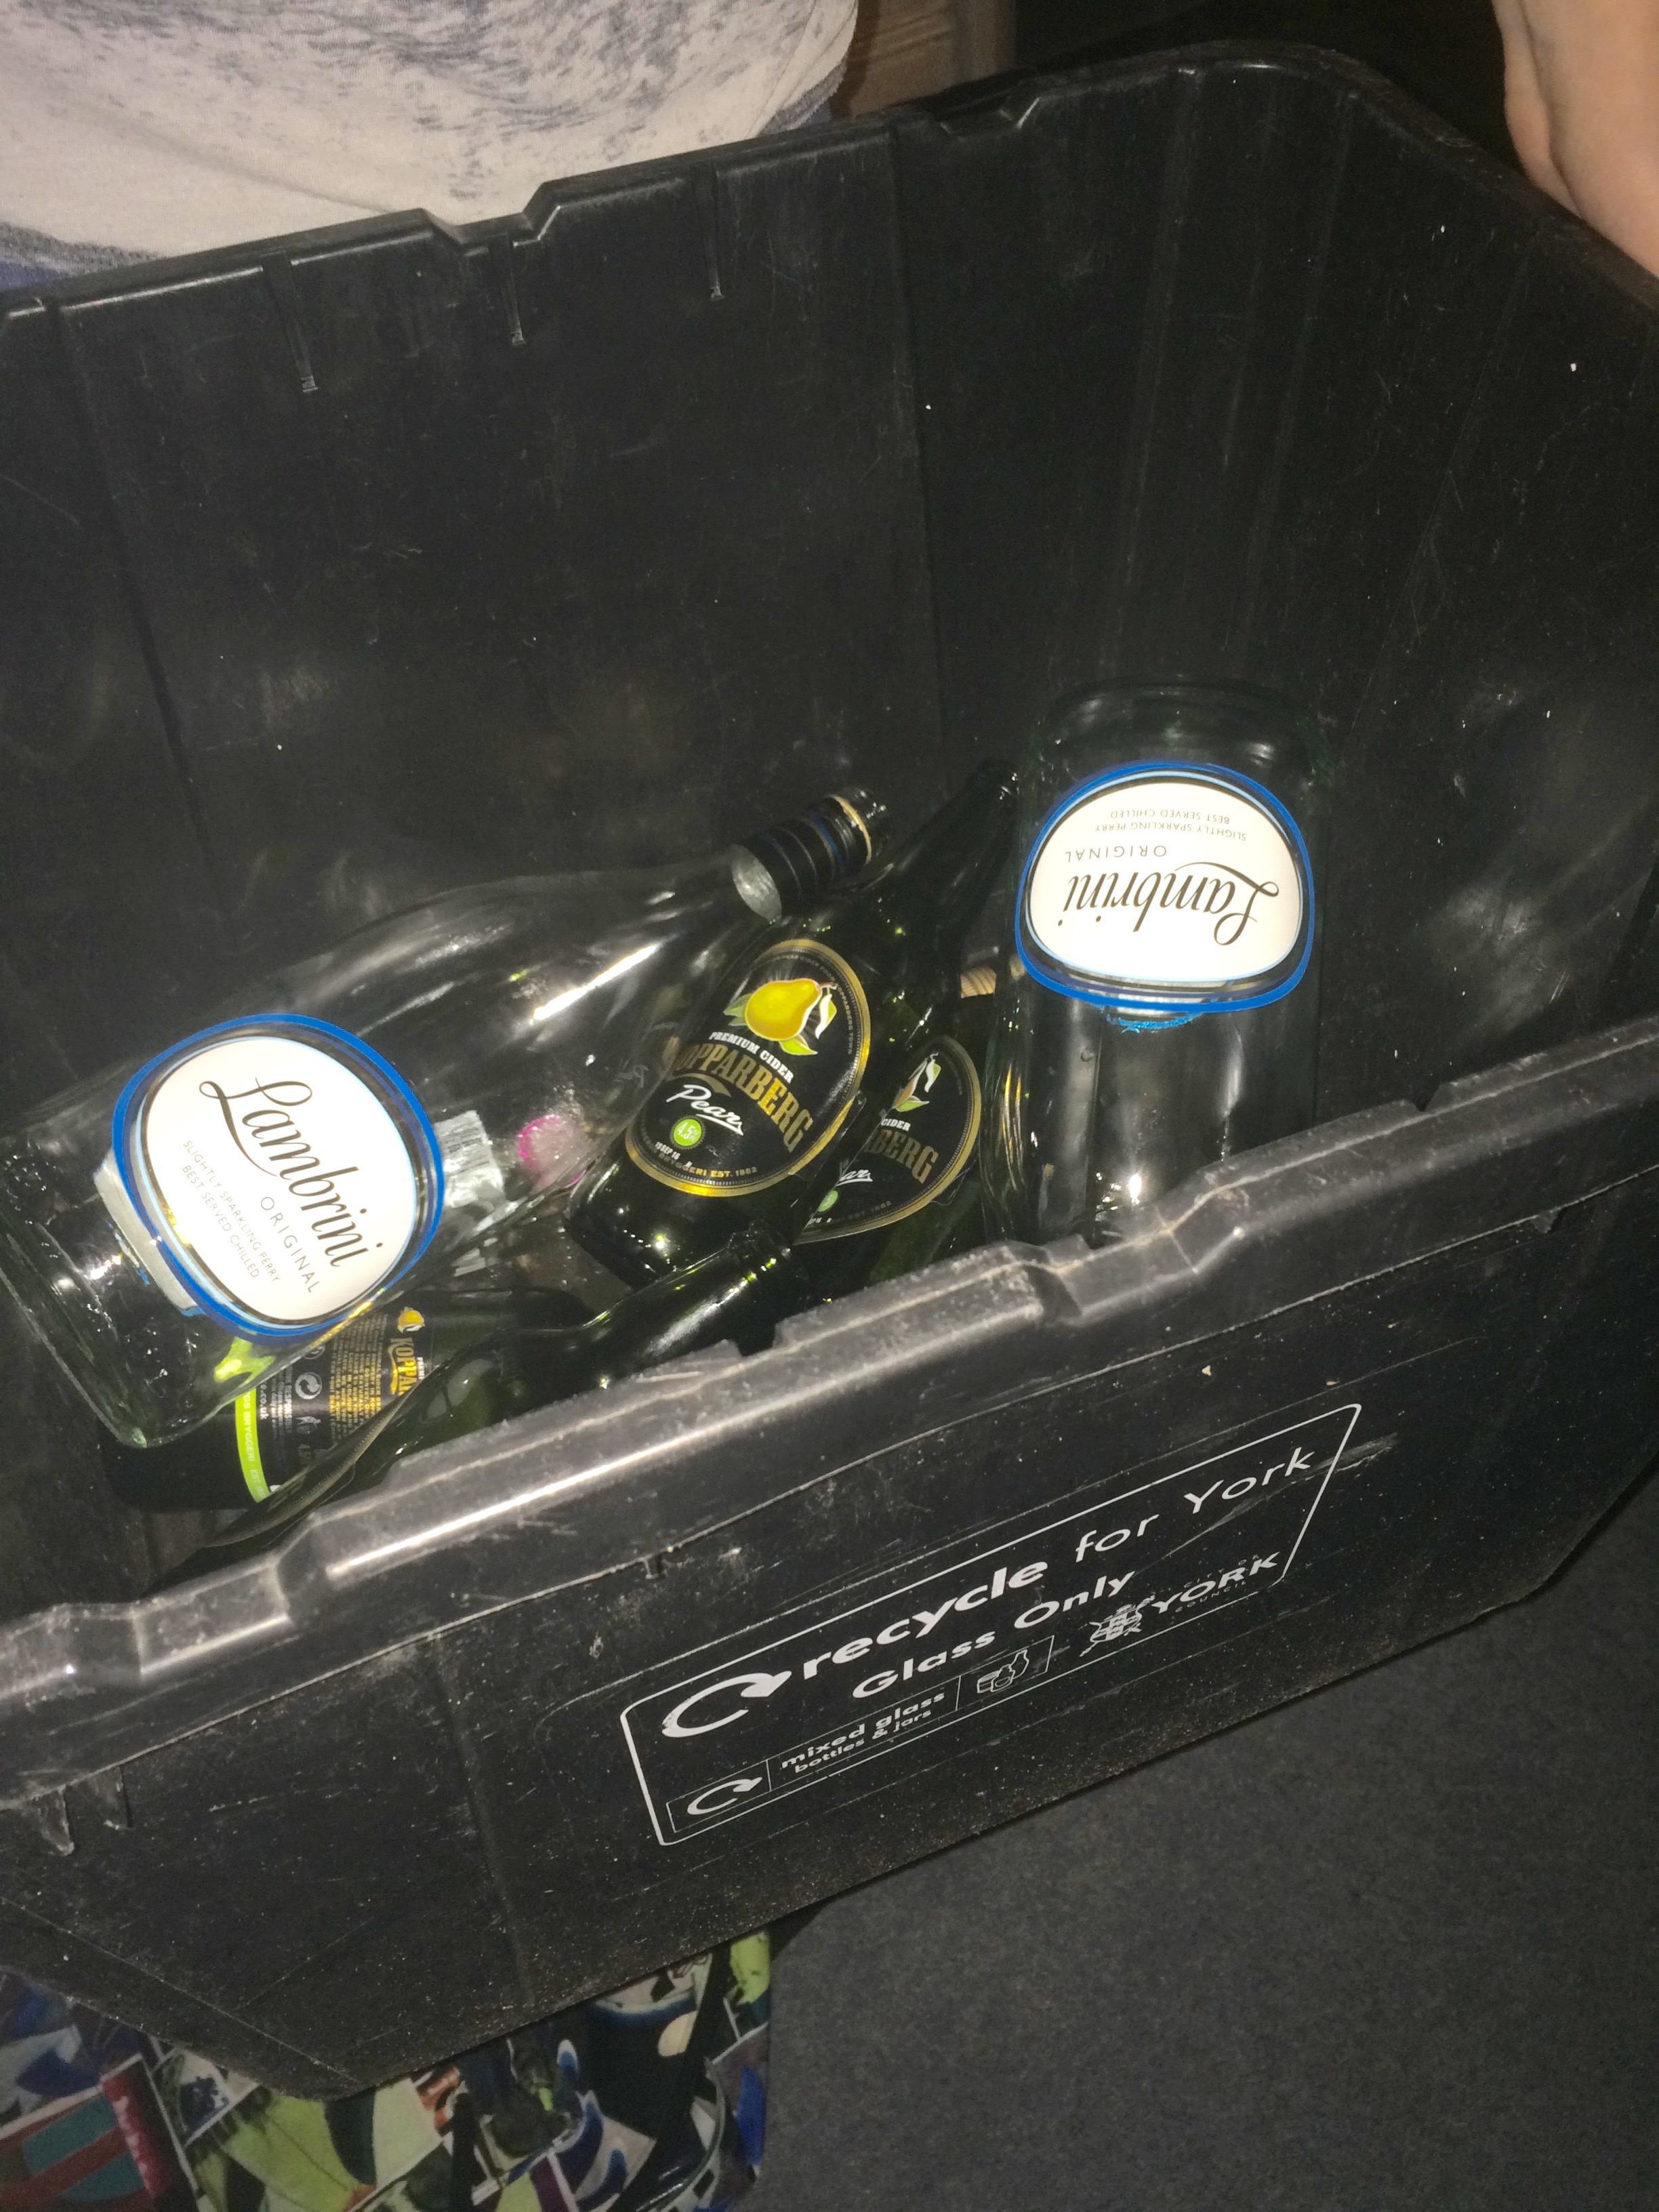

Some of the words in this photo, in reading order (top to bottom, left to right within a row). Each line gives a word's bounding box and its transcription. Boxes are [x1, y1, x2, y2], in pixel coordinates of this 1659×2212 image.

[1094, 823, 1126, 833] PERRY
[1110, 809, 1155, 819] CHILLED
[1130, 822, 1192, 832] SPARKLING
[1160, 810, 1201, 821] SERVED
[1197, 825, 1246, 842] SLIGHTLY
[1207, 814, 1230, 825] BEST
[1065, 845, 1167, 863] ORIGINAL
[1057, 861, 1279, 945] Lambrini
[708, 1031, 760, 1055] PREMIUM
[759, 1050, 795, 1084] CIDER
[666, 1084, 744, 1136] Pear
[880, 1118, 912, 1132] CIDER
[199, 1077, 384, 1268] Lambrini
[182, 1164, 205, 1189] BEST
[201, 1191, 232, 1232] SERVED
[230, 1235, 260, 1278] CHILLED
[183, 1141, 223, 1188] SLIGHTLY
[220, 1191, 262, 1251] SPARKLING
[258, 1252, 281, 1282] PERRY
[260, 1195, 322, 1293] ORIGINAL
[803, 1561, 1048, 1680] recycle
[1075, 1513, 1160, 1563] for
[1183, 1446, 1315, 1515] York
[1151, 1551, 1281, 1614] YORK
[852, 1631, 996, 1698] Glass
[1014, 1570, 1136, 1629] Only
[781, 1722, 865, 1769] mixed
[875, 1692, 945, 1729] glass
[794, 1738, 865, 1774] bottles
[871, 1727, 888, 1740] &
[893, 1709, 932, 1733] jars
